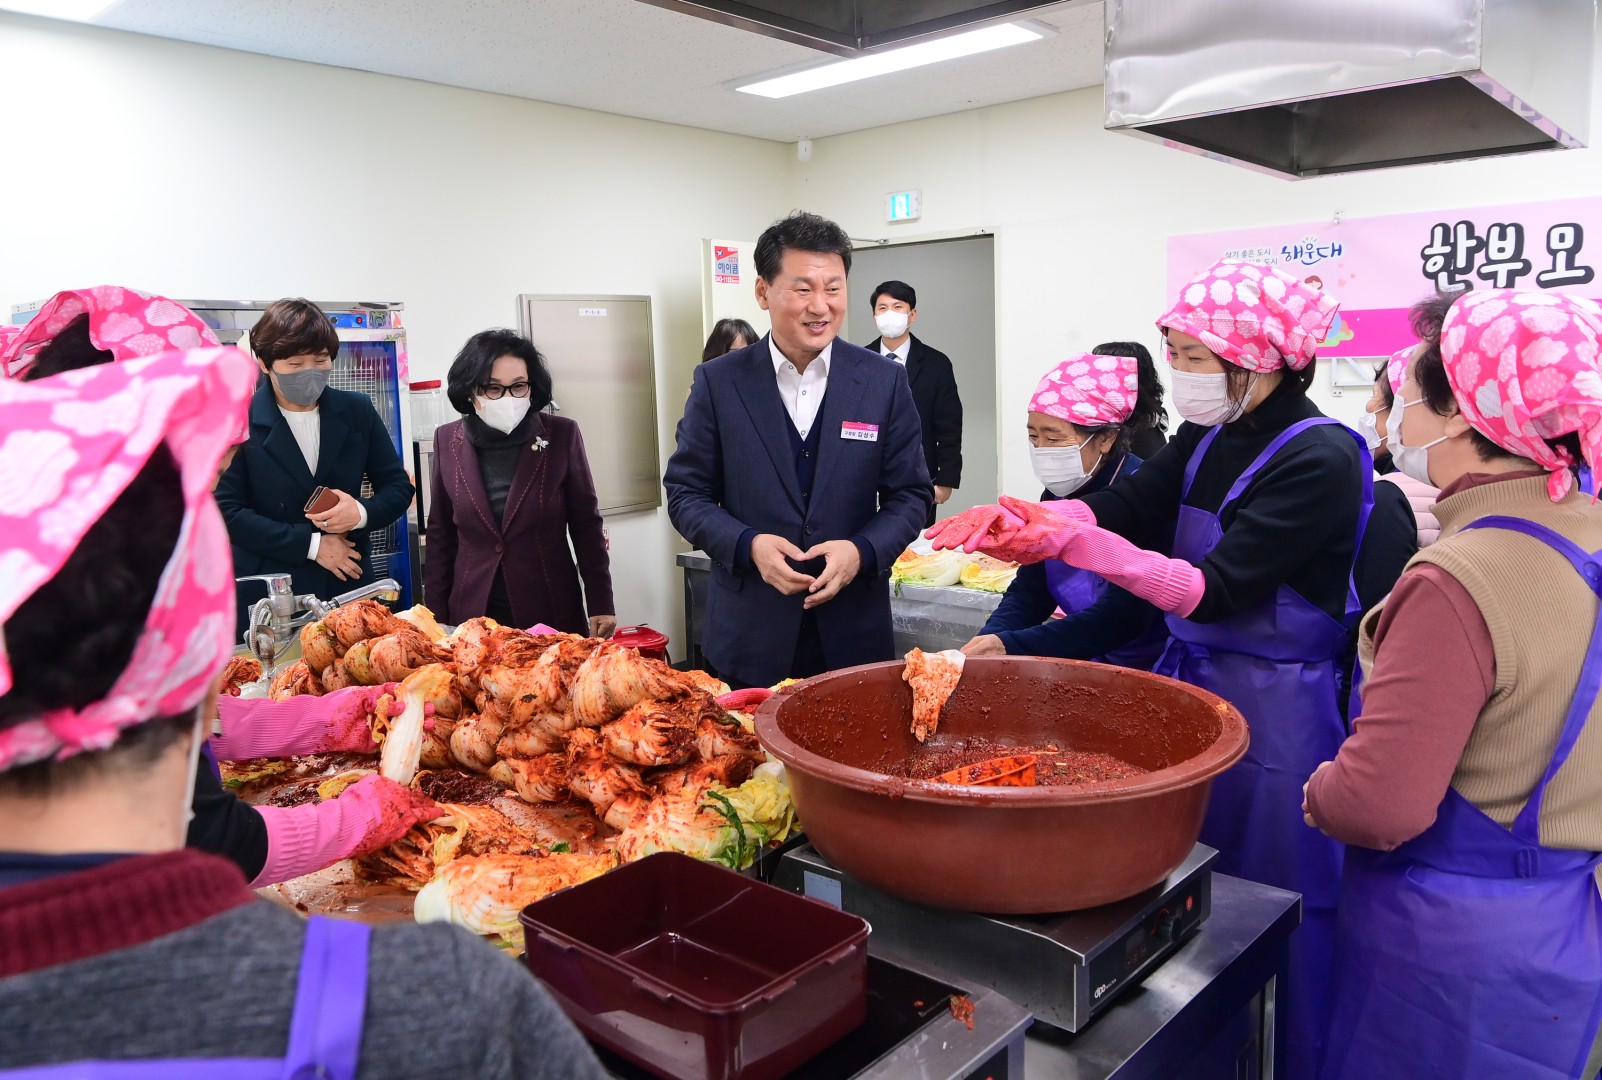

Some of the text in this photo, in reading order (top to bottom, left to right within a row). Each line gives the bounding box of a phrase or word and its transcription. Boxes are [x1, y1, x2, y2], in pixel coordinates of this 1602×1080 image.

[1225, 248, 1271, 259] 살기 좋은 도시
[1281, 239, 1342, 265] 해운대
[717, 262, 739, 275] 에이콤
